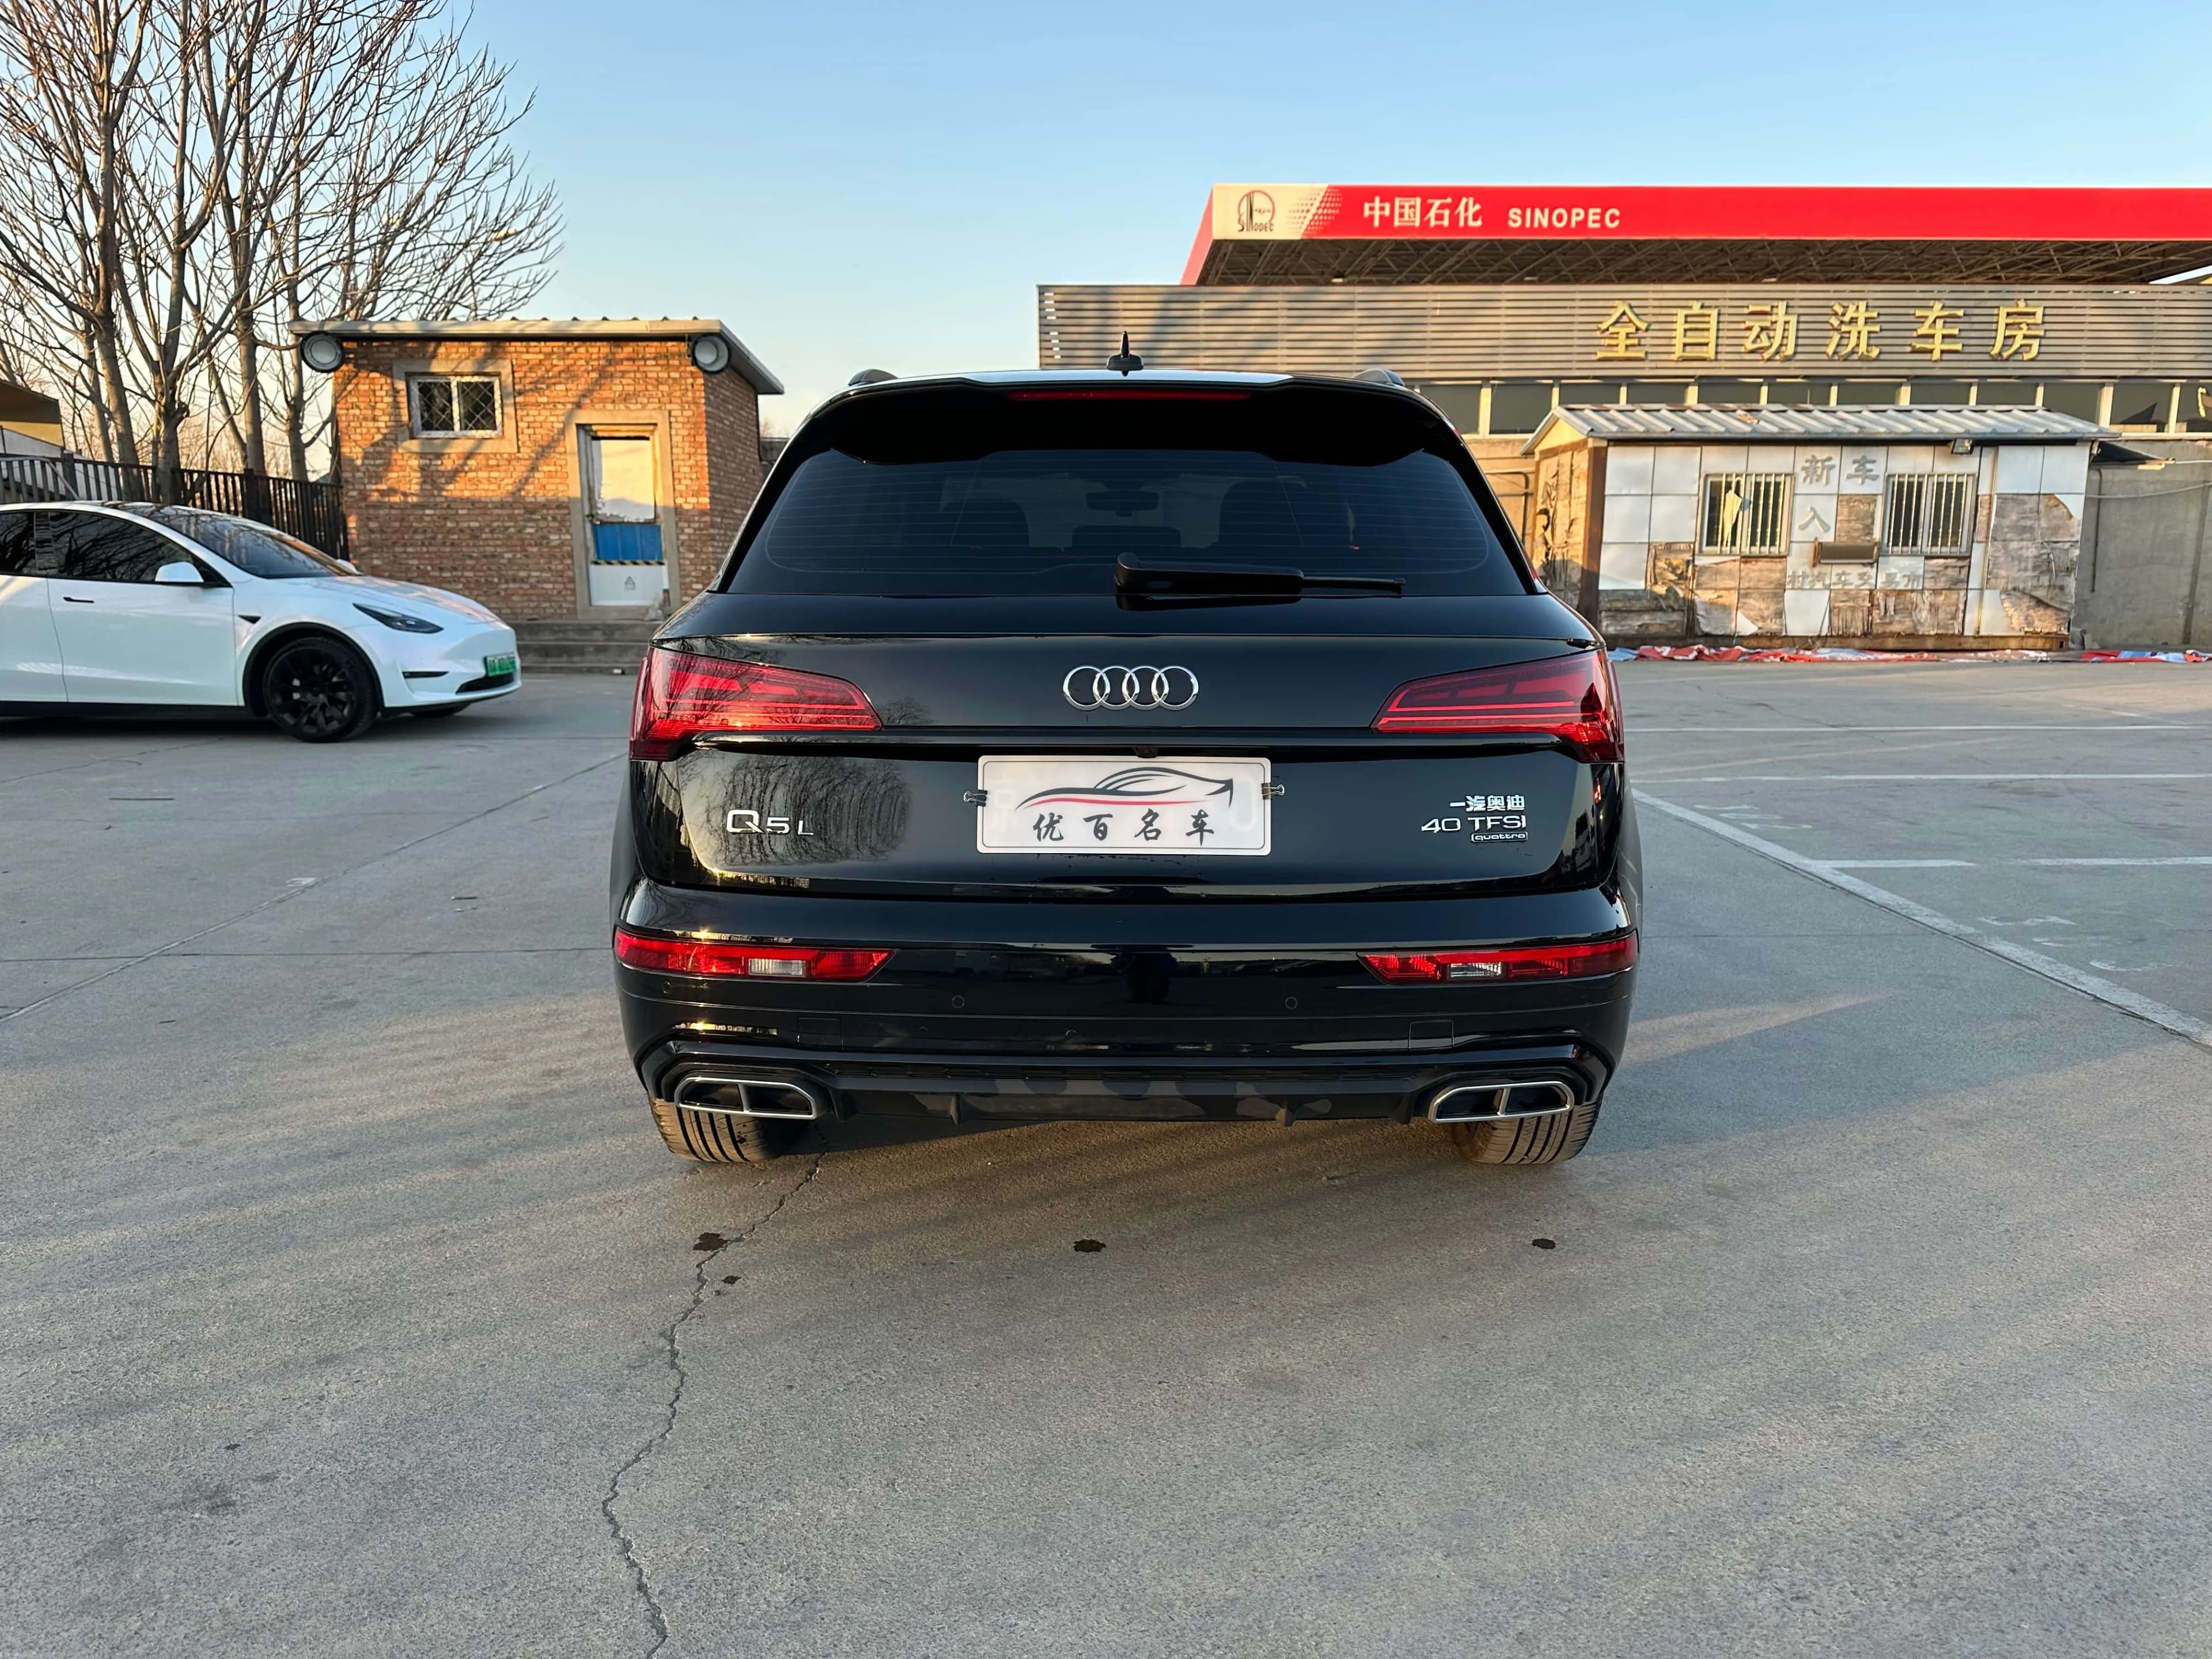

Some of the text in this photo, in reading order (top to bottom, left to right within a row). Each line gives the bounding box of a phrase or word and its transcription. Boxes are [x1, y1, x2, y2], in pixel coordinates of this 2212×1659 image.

[1363, 196, 1620, 228] 中国石化 SINOPEC
[1596, 299, 2047, 362] 全自动洗车房
[1801, 454, 1880, 486] 新车
[1798, 506, 1831, 533] 入
[1449, 794, 1525, 812] 一汽奥迪
[1032, 808, 1215, 846] 优百名车
[1421, 815, 1527, 833] 40 TFSI
[1475, 833, 1525, 841] quattro
